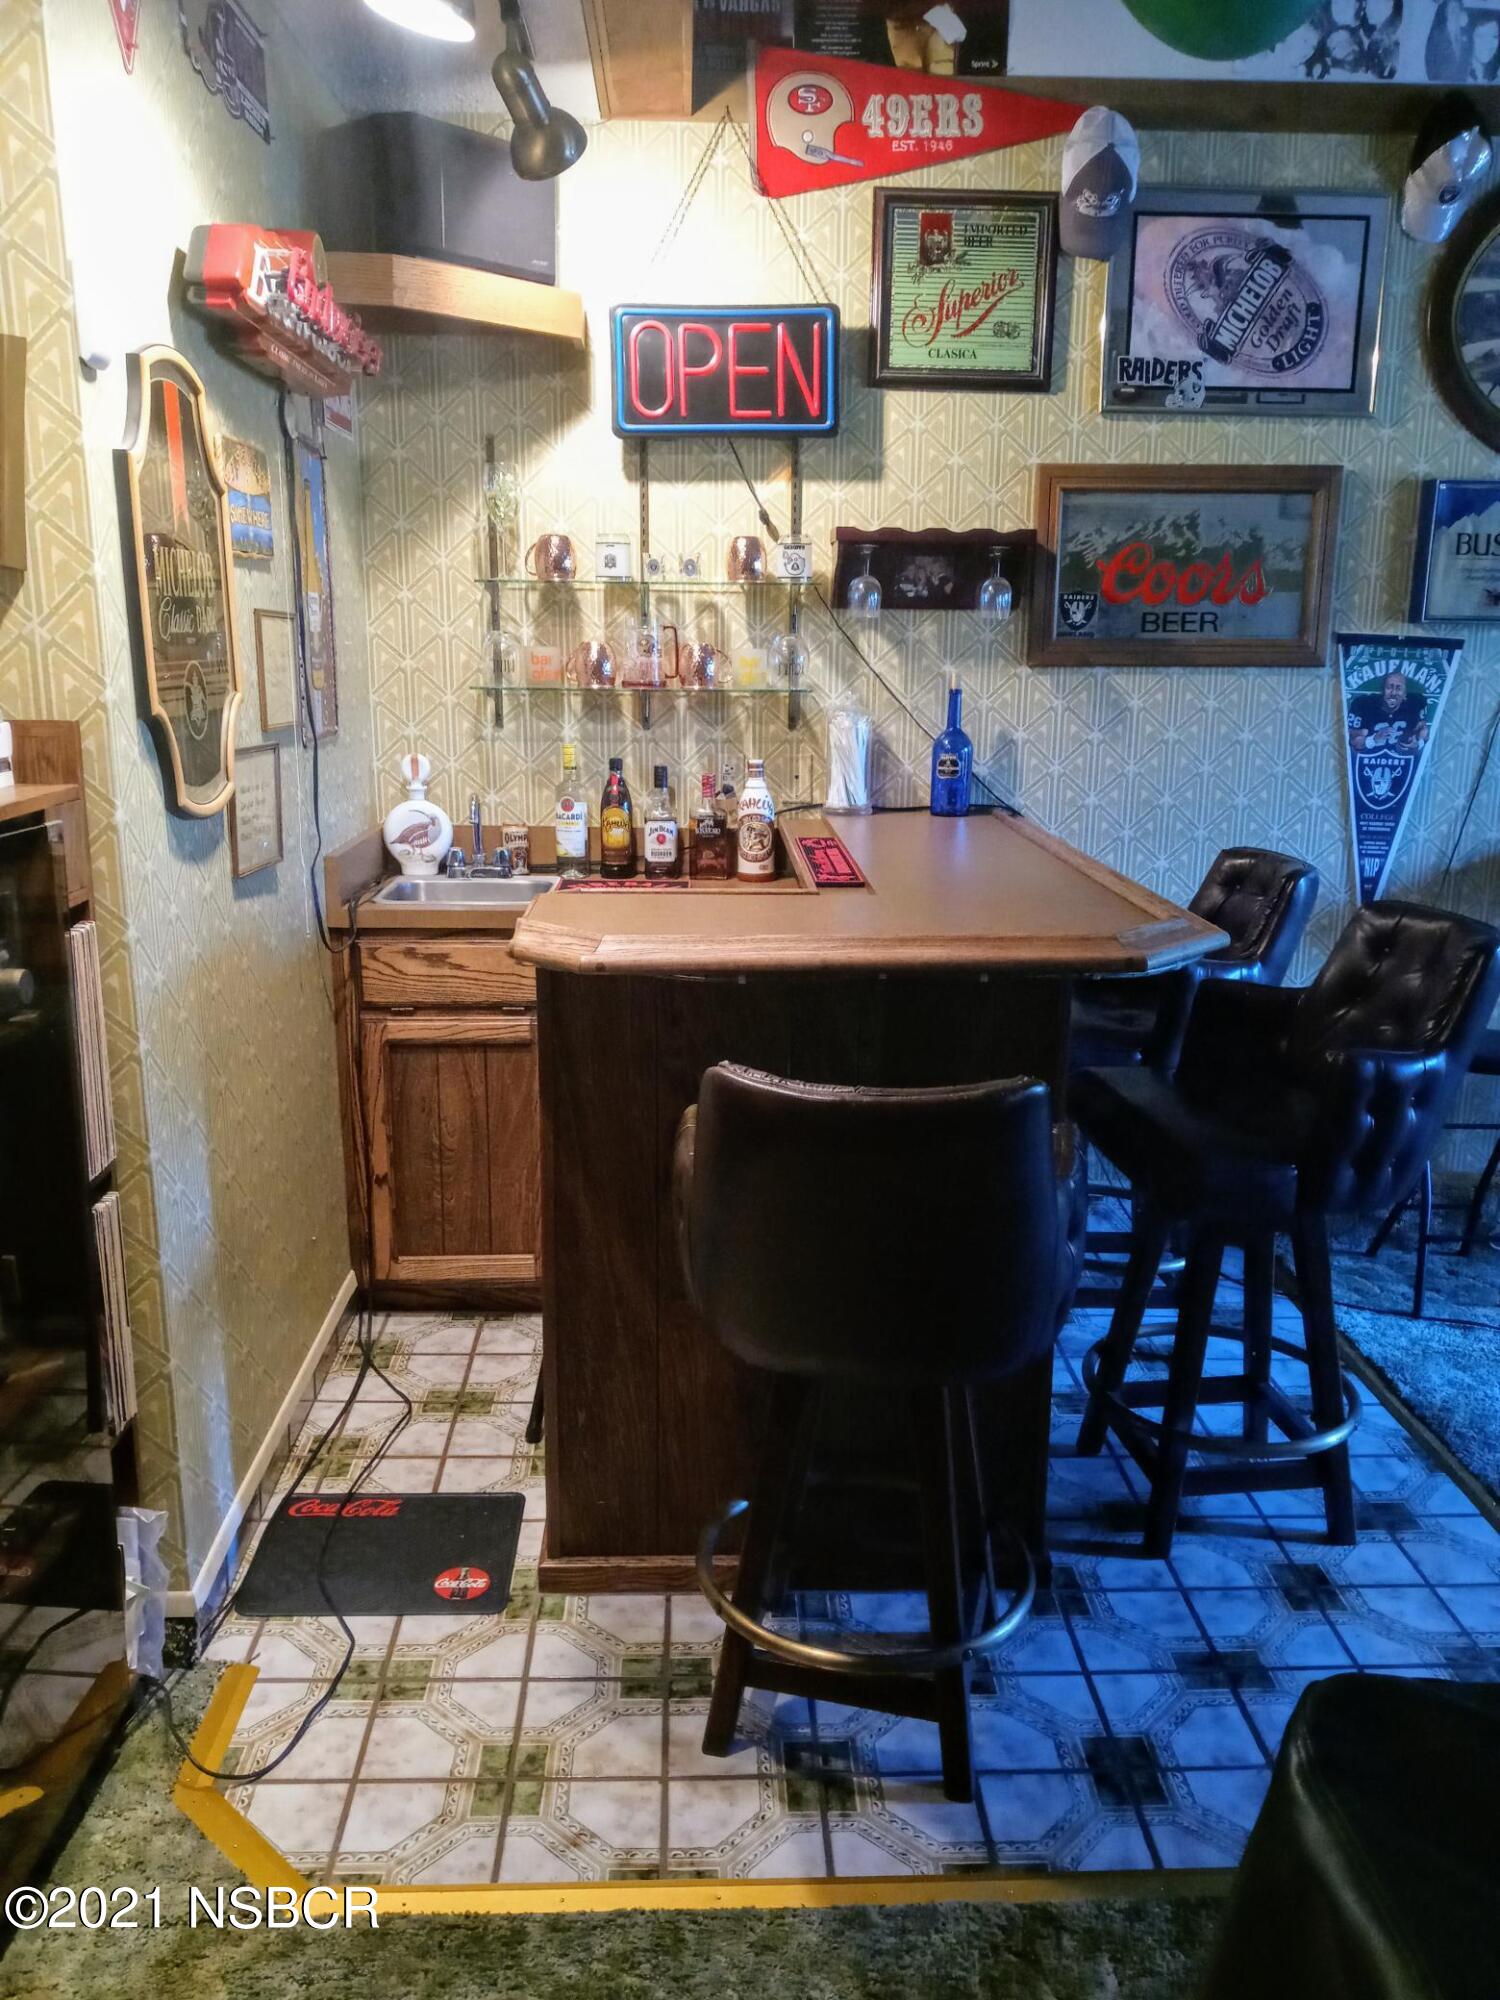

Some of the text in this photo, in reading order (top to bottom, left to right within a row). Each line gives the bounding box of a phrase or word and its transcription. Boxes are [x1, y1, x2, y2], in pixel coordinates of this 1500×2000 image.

[862, 93, 985, 138] 49ERS
[892, 139, 953, 152] EST. 1946
[964, 223, 1028, 235] IMPORTED
[964, 236, 993, 247] BEER
[902, 268, 1024, 347] Superior
[1213, 258, 1283, 352] MICHELOB
[1250, 289, 1293, 348] Golden
[1265, 302, 1302, 353] Draft
[1281, 314, 1321, 369] LIGHT
[629, 319, 821, 420] OPEN
[928, 348, 977, 360] CLASICA
[1118, 356, 1203, 385] RAIDERS
[1096, 542, 1273, 607] Coors
[1141, 611, 1219, 633] BEER
[1345, 659, 1442, 693] KAUFMAN
[1363, 758, 1405, 766] RAIDERS
